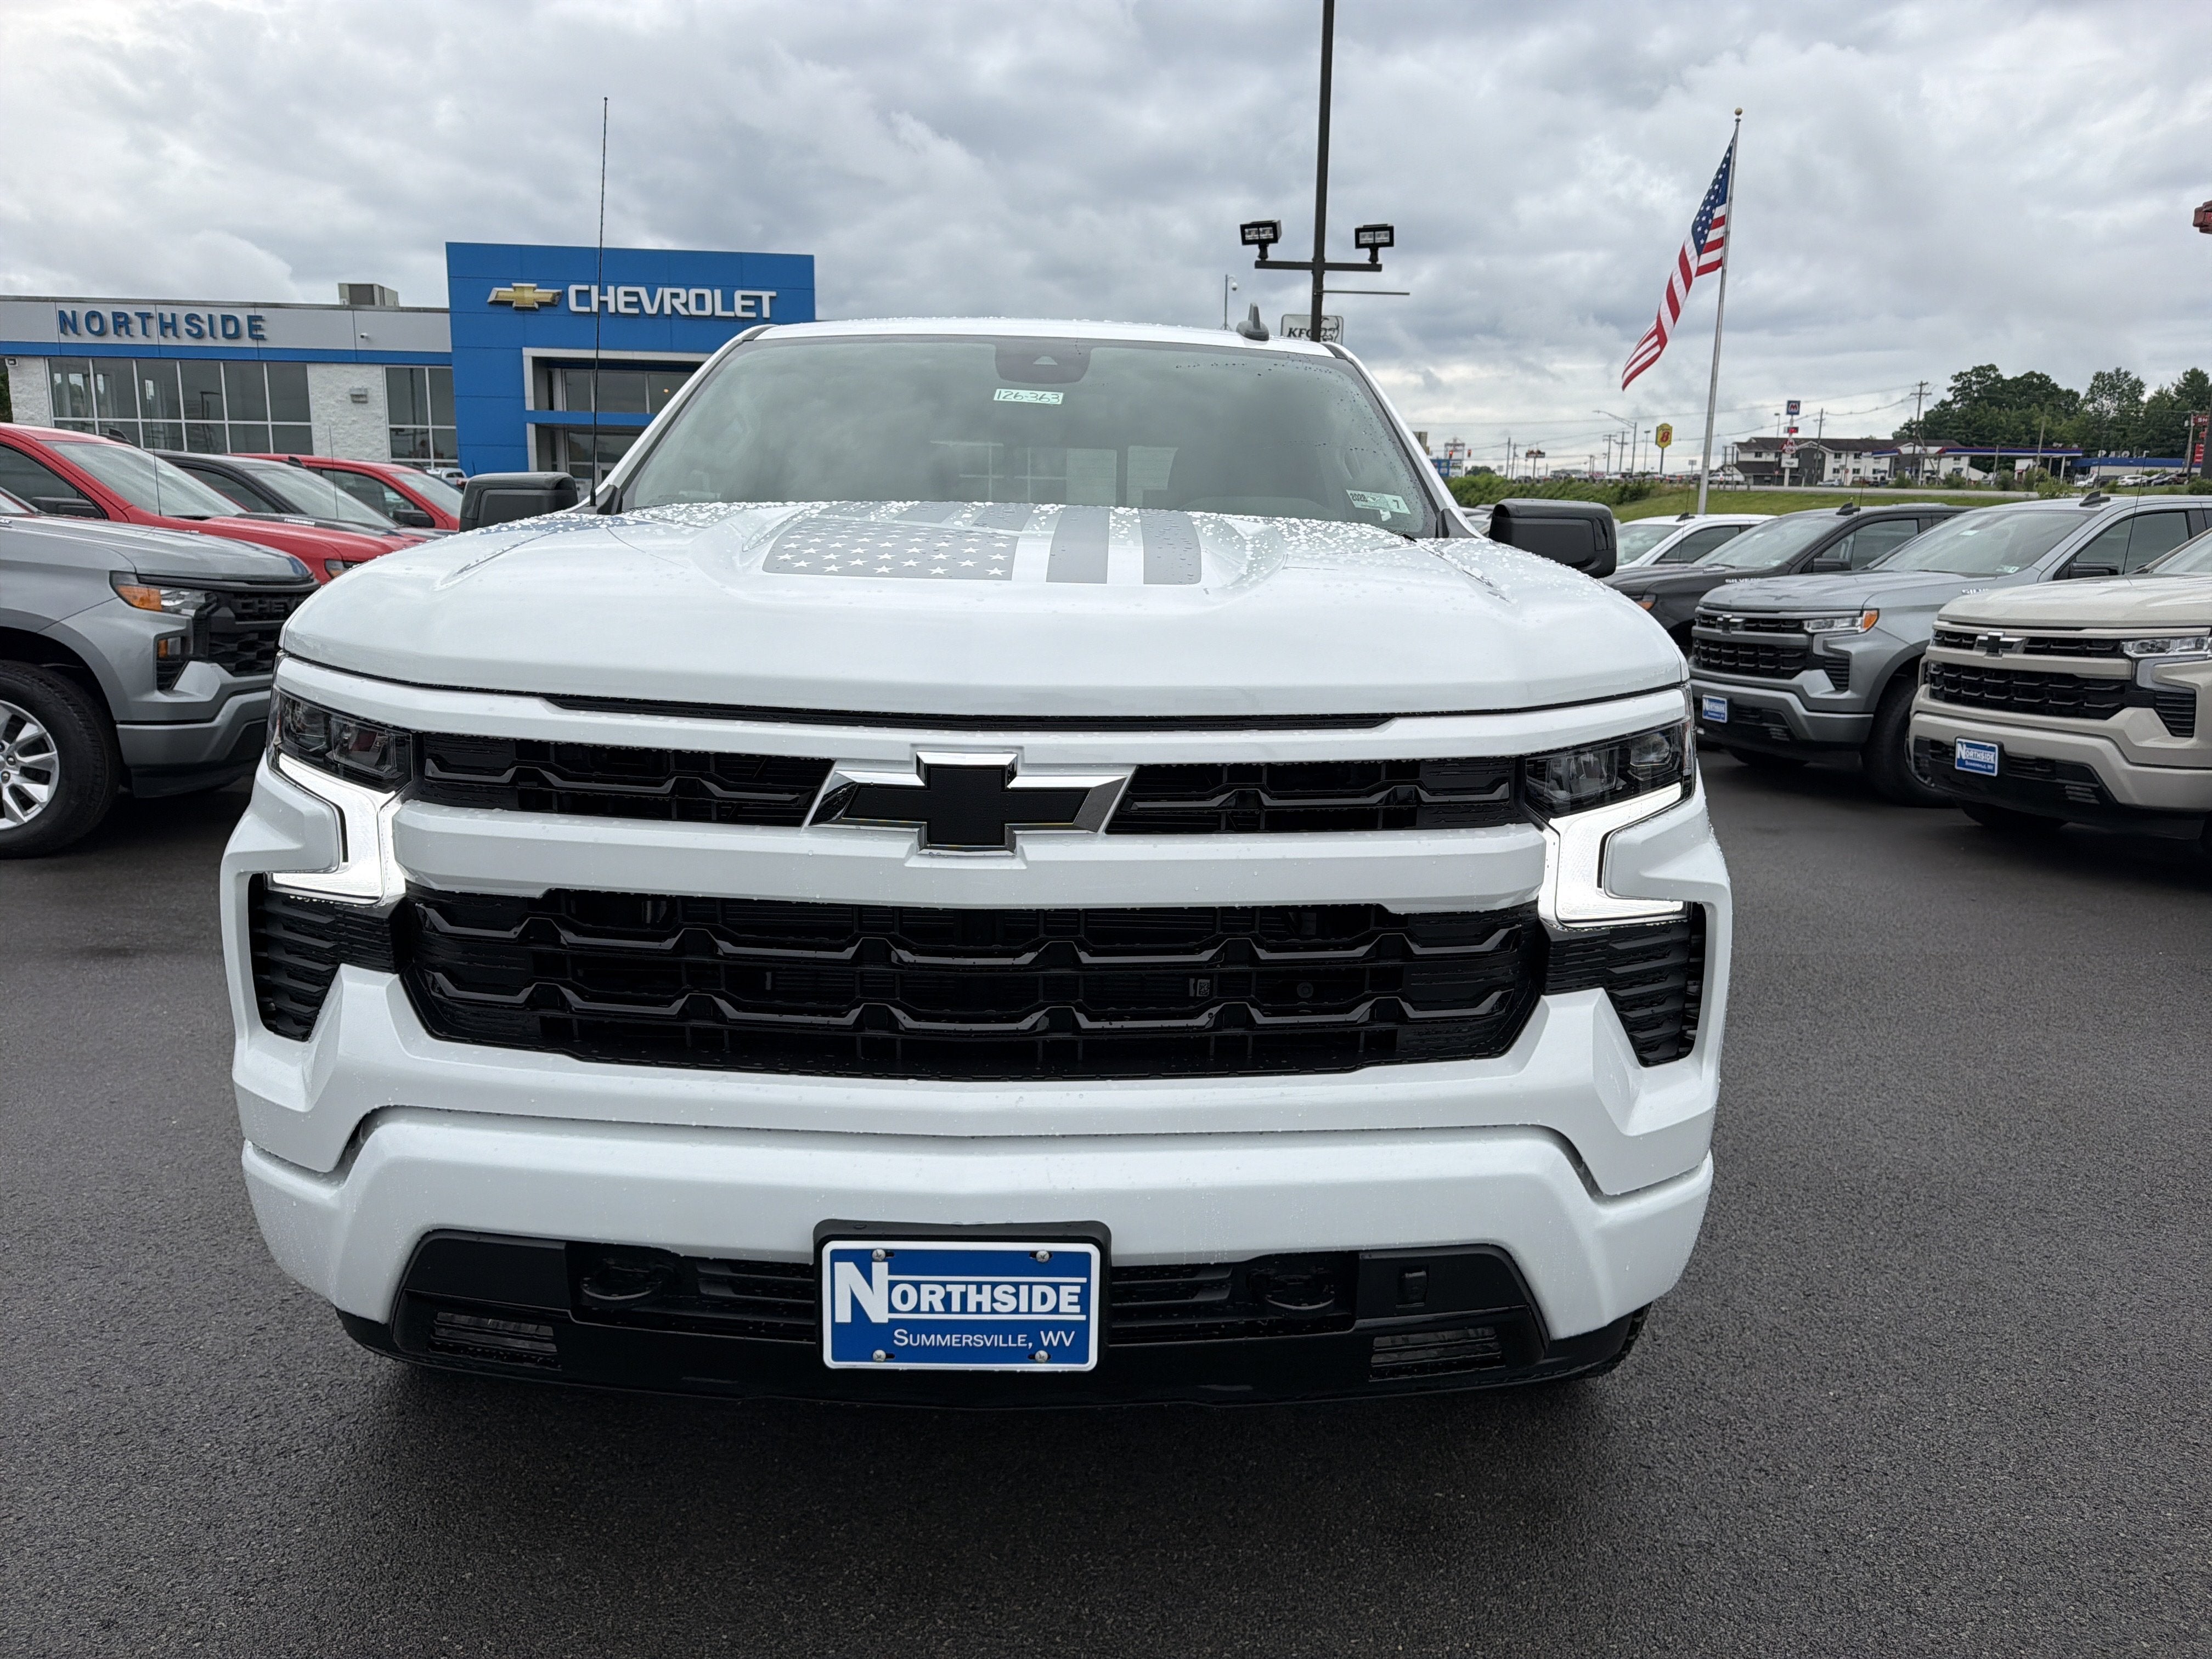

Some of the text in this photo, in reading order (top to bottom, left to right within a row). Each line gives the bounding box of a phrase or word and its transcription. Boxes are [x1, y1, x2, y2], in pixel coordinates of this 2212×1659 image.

[568, 284, 777, 318] CHEVROLET
[58, 309, 267, 340] NORTHSIDE
[997, 390, 1060, 404] 126-363
[834, 1261, 1081, 1323] NORTHSIDE
[893, 1329, 1076, 1350] SUMMERSVILLE, WV
